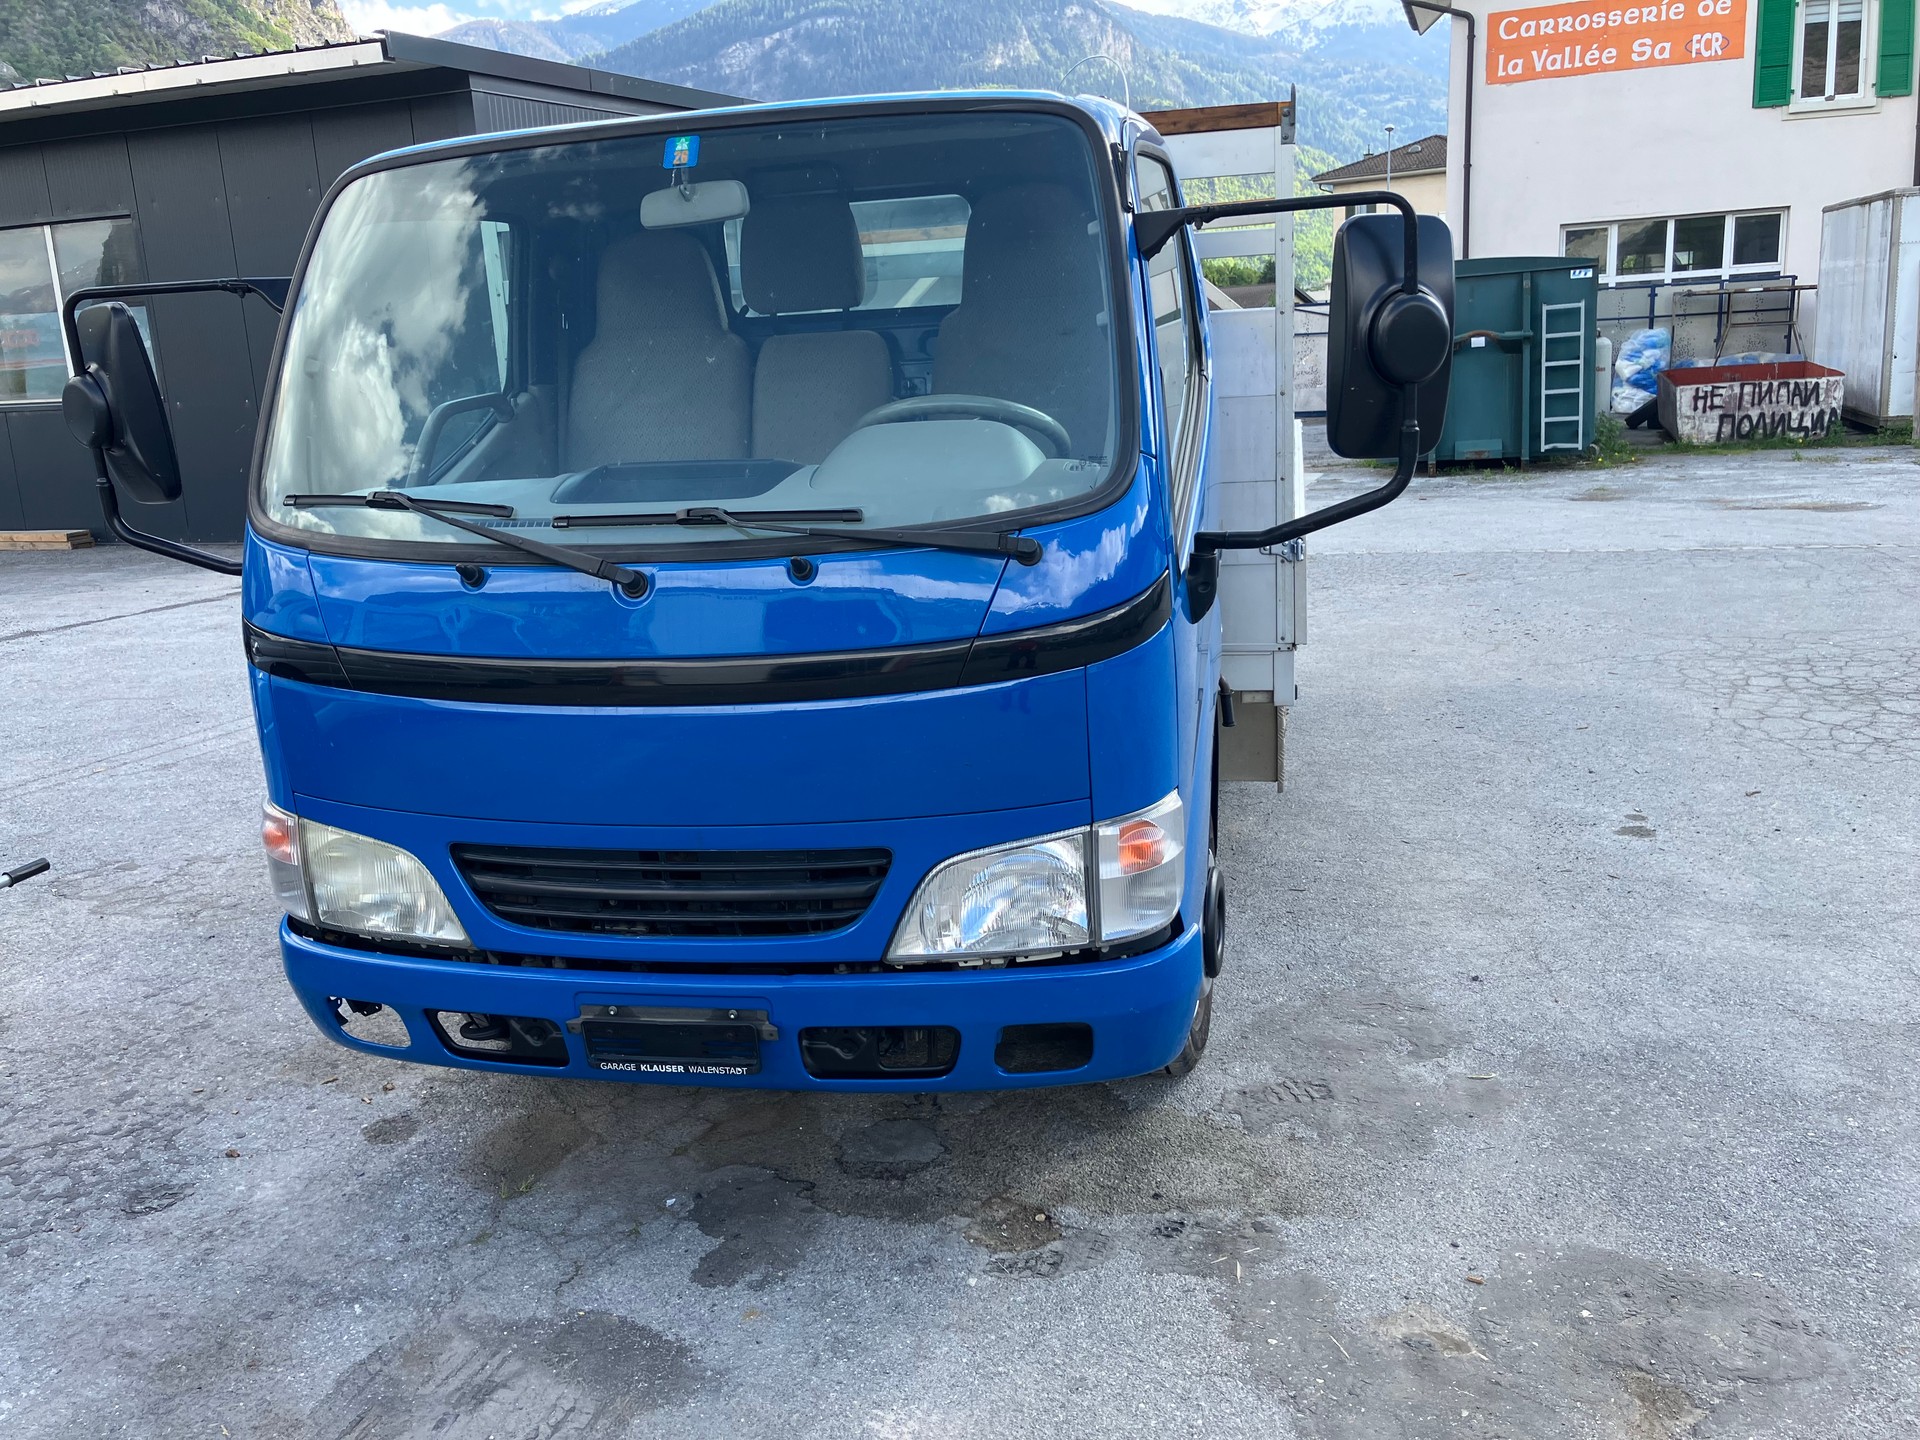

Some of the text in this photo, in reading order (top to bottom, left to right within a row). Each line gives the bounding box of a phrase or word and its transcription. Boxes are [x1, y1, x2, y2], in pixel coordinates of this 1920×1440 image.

[1498, 32, 1722, 77] la Vallée Sa FCR
[600, 1062, 748, 1076] GARAGE KLAUSER WALENSTADT
